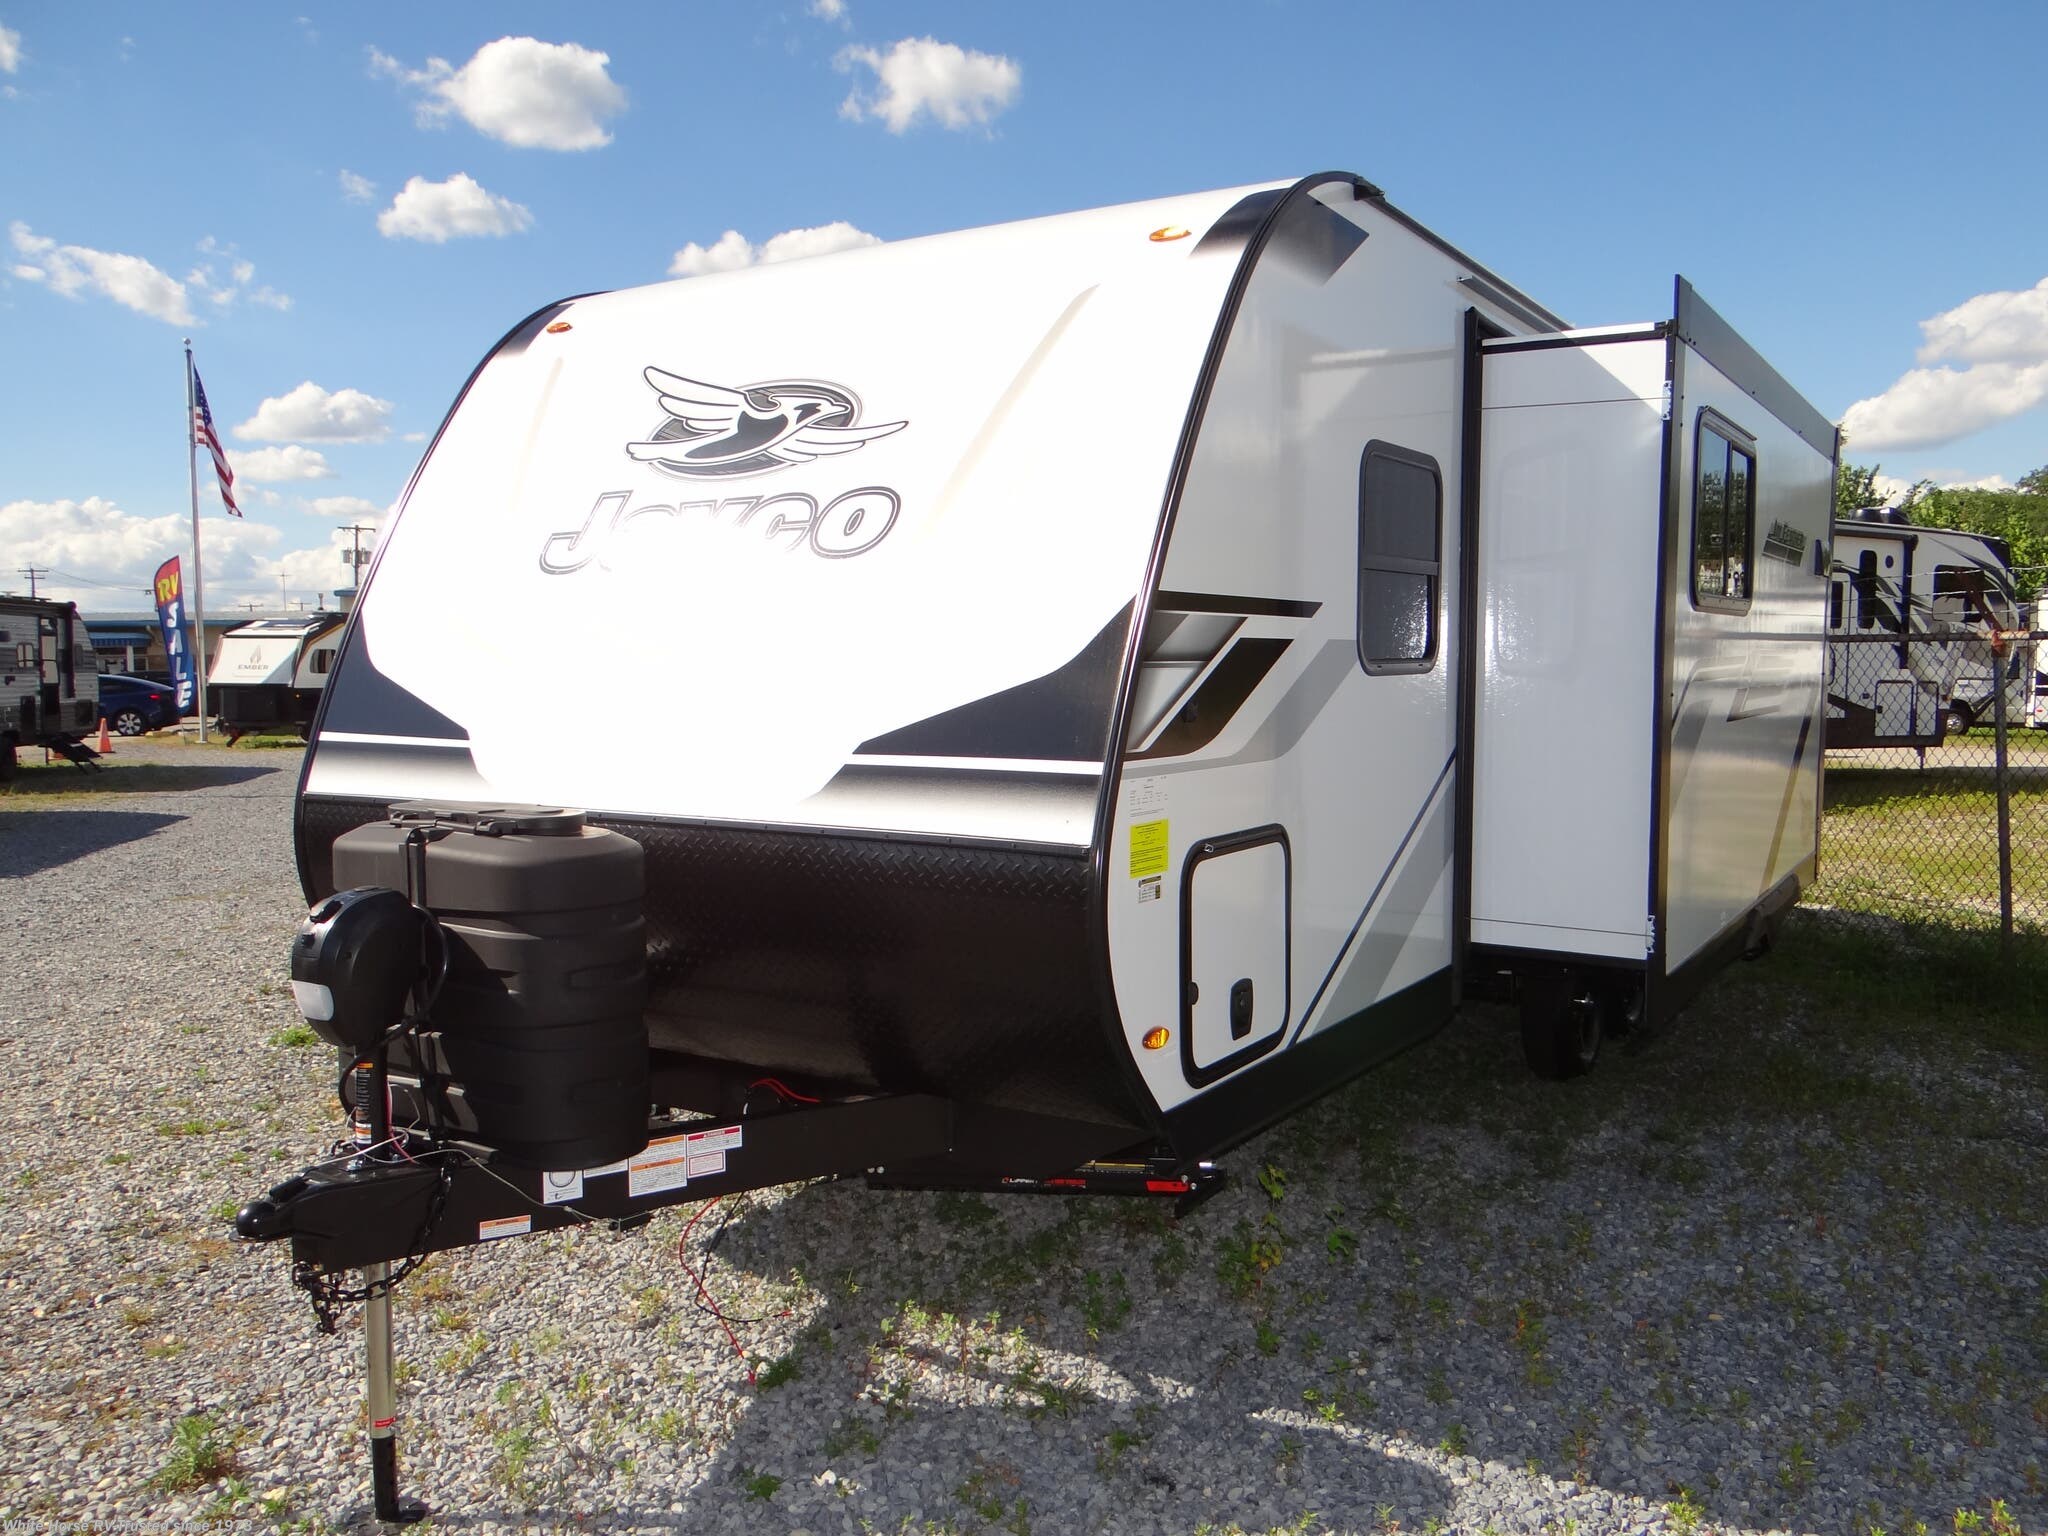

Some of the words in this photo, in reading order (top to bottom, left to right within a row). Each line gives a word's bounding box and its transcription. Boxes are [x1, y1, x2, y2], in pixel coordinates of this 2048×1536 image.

[539, 485, 901, 575] Jco
[157, 572, 179, 602] RV
[166, 601, 192, 708] SALE
